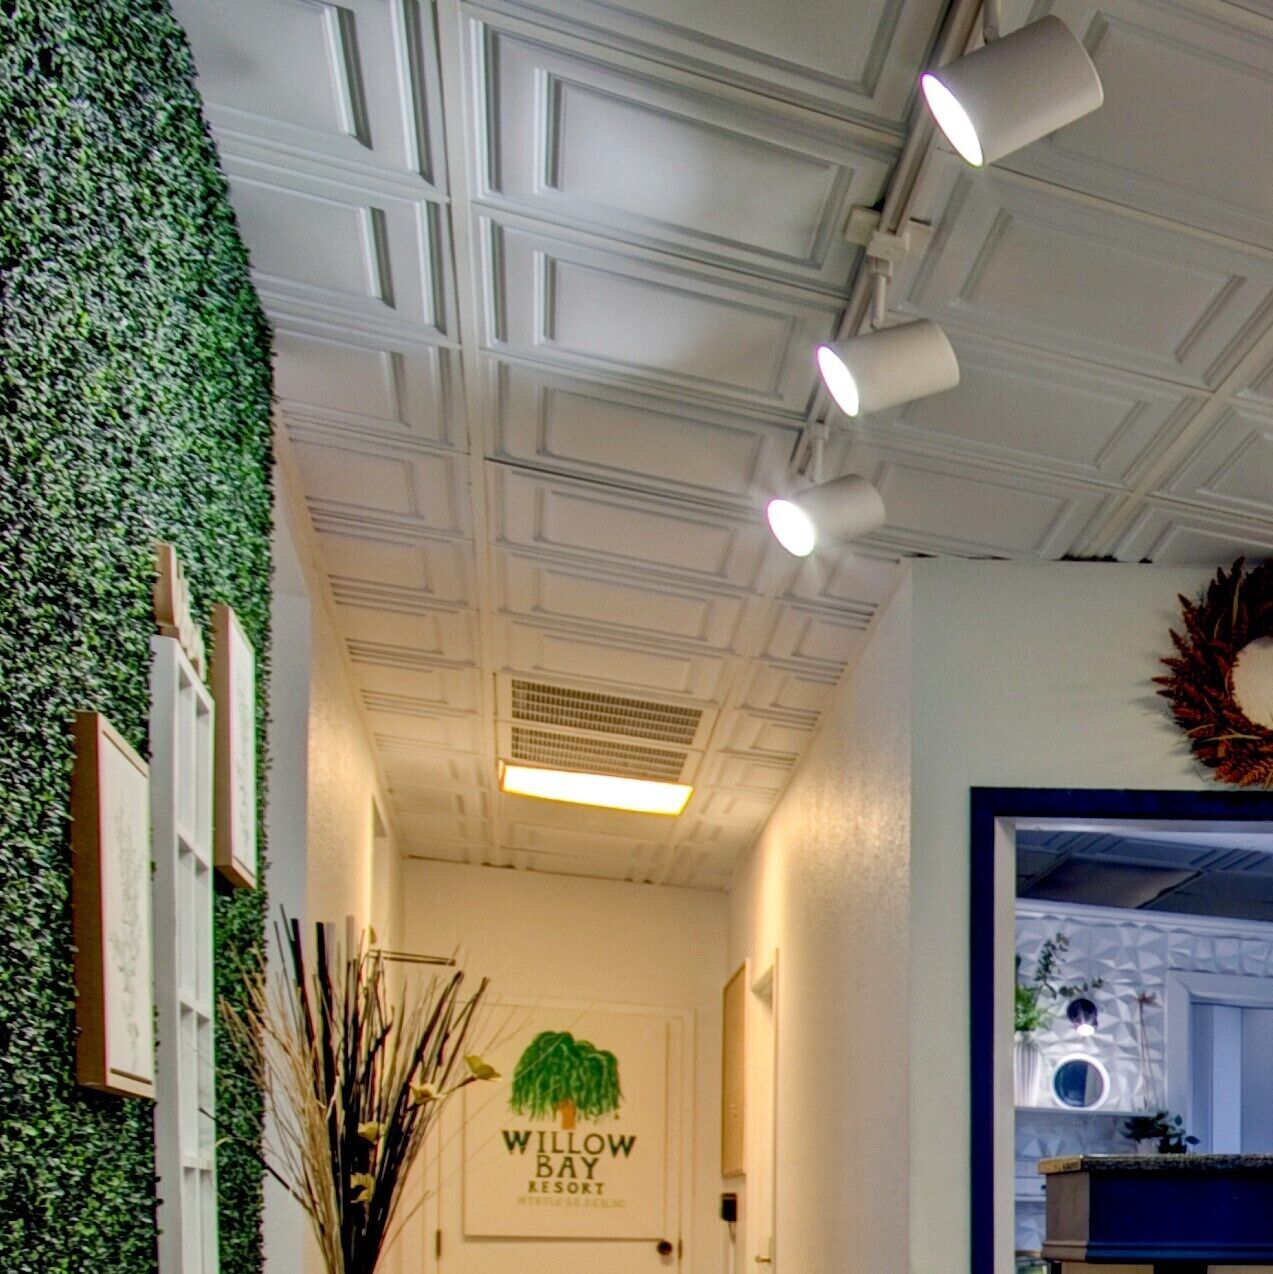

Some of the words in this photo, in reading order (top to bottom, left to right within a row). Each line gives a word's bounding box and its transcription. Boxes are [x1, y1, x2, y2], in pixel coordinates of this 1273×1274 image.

[502, 1130, 637, 1158] WILLOW
[536, 1154, 599, 1180] BAY
[528, 1181, 604, 1195] RESORT
